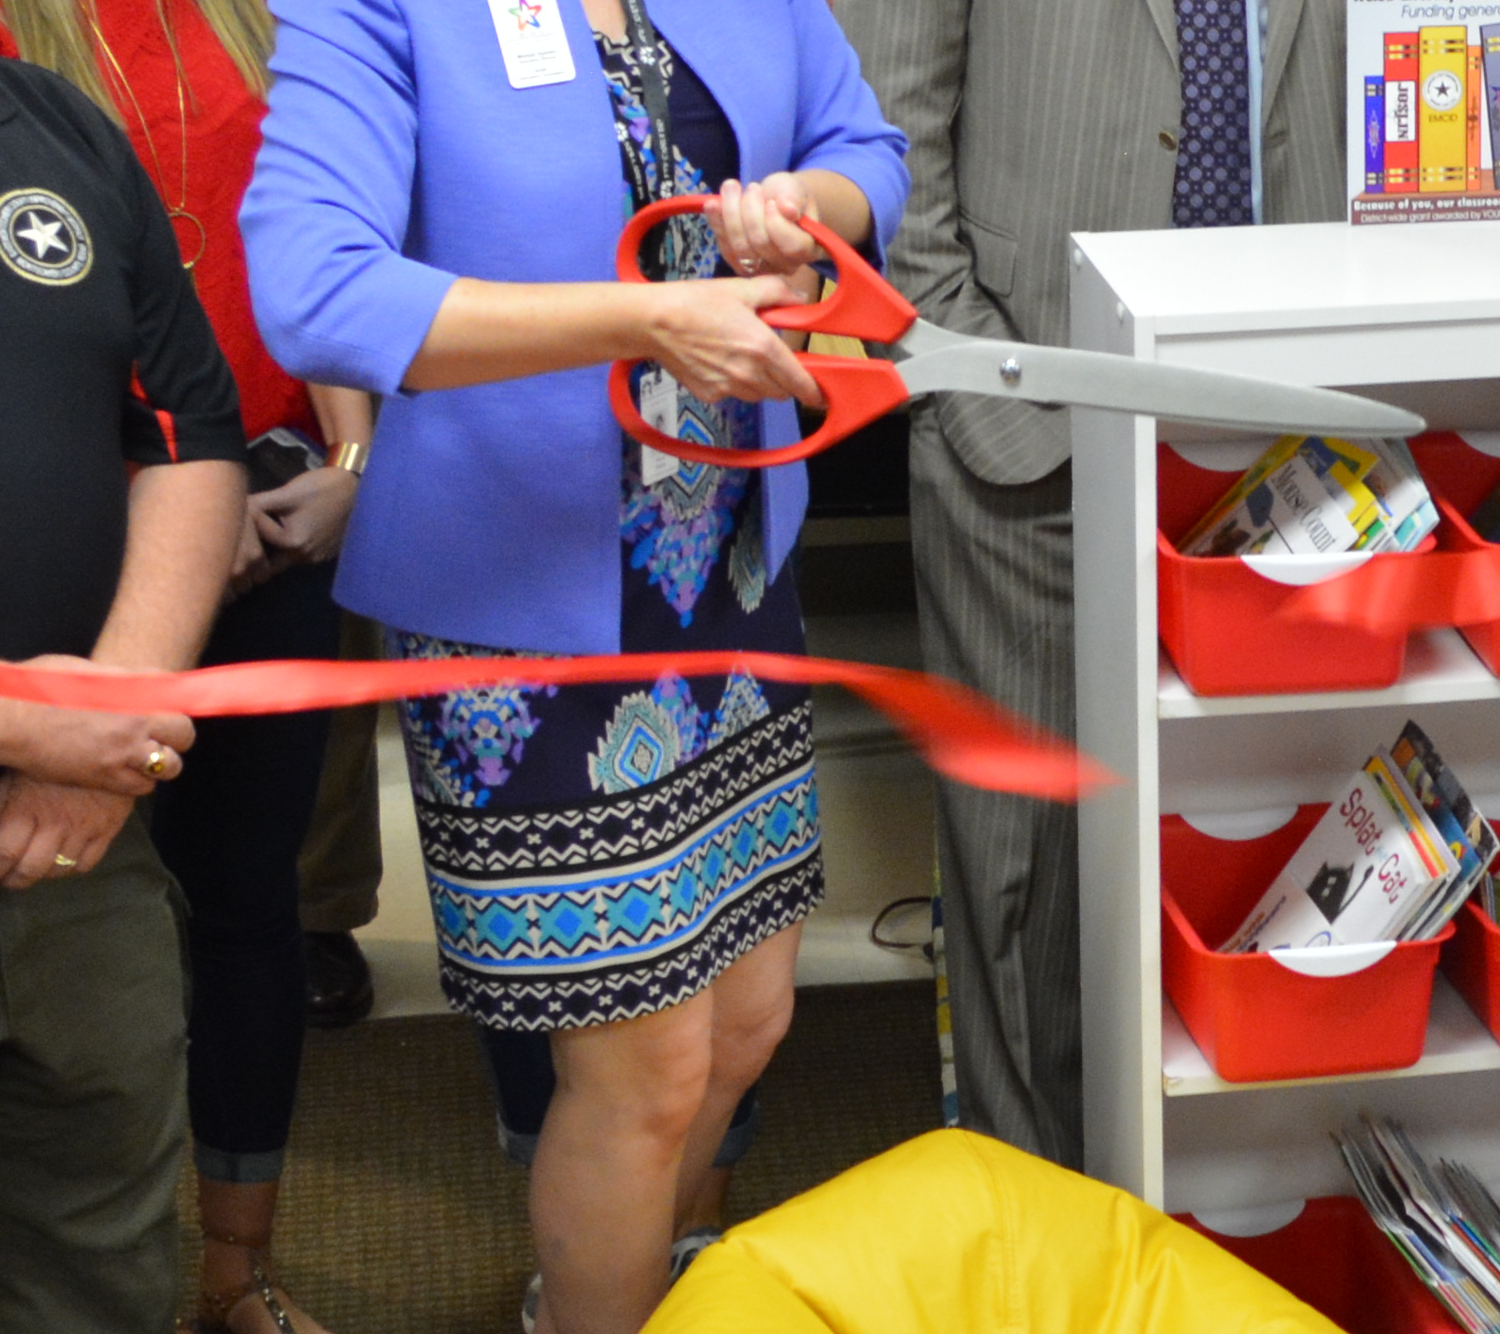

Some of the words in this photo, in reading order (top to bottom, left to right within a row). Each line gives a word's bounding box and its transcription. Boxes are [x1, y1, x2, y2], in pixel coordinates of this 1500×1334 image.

[1401, 4, 1455, 20] Funding
[1354, 199, 1395, 210] Because
[1398, 198, 1409, 209] of
[1412, 199, 1435, 211] you,
[1437, 199, 1455, 208] our
[1271, 464, 1308, 516] Mouse
[1300, 506, 1338, 553] Count
[1339, 787, 1384, 857] Splat
[1378, 853, 1408, 905] Cat
